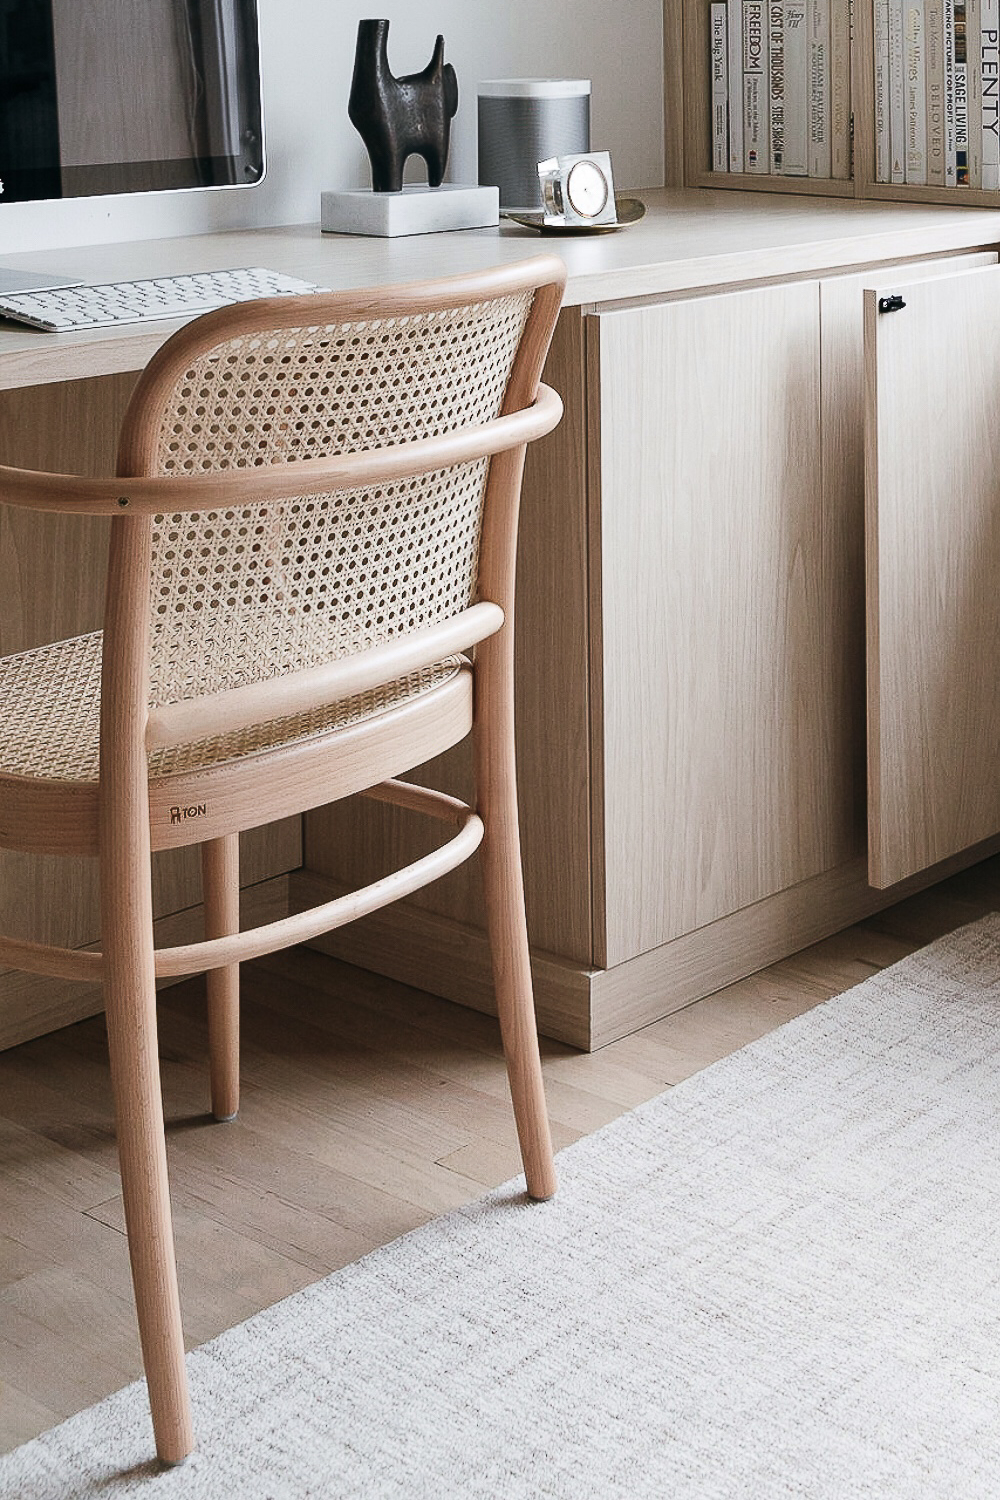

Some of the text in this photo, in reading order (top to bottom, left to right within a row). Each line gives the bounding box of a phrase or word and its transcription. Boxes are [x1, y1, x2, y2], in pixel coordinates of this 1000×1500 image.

[749, 4, 761, 68] FREEDOM
[771, 6, 784, 29] CAST
[771, 32, 784, 43] OF
[712, 16, 723, 81] The Big Yank
[908, 45, 920, 81] Wives
[771, 47, 784, 101] THOUSANDS
[981, 29, 999, 137] PLENTY
[772, 106, 785, 125] STEVE
[909, 86, 917, 110] James
[931, 84, 940, 157] BELOVED
[955, 75, 966, 143] SAGE LIVING
[910, 111, 918, 149] Patterson
